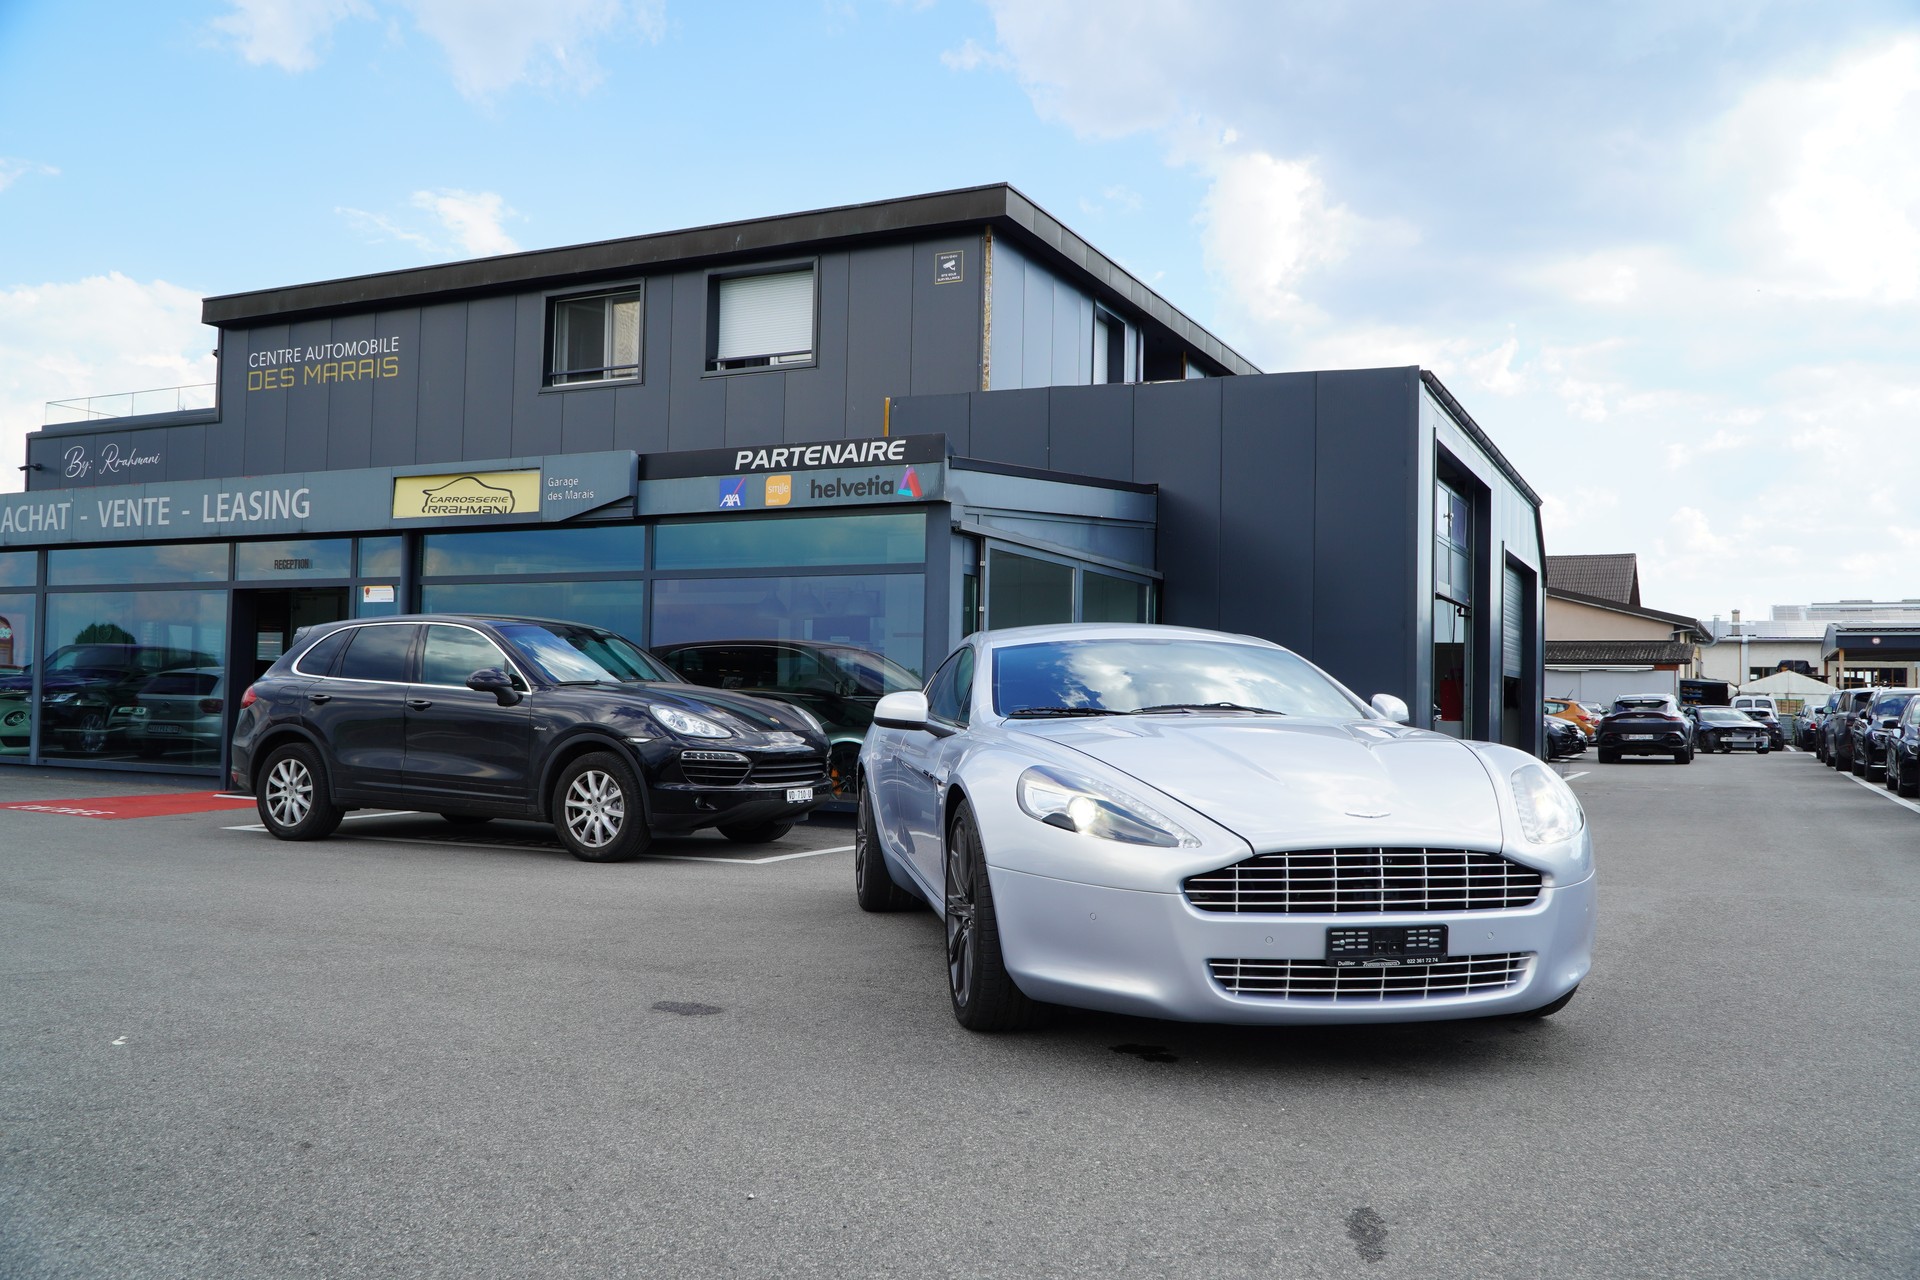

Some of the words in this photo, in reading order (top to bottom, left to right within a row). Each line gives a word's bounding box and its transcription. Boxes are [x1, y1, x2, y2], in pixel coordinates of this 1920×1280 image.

[249, 347, 302, 368] CENTRE
[305, 336, 400, 361] AUTOMOBILE
[248, 367, 295, 391] DES
[304, 356, 399, 386] MARAIS
[64, 445, 93, 478] By:
[99, 443, 160, 475] Rrahmani
[734, 440, 907, 471] PARTENAIRE
[547, 477, 579, 488] Garage
[810, 475, 894, 499] helvetia
[430, 496, 509, 504] CARROSSERIE
[547, 491, 563, 501] des
[565, 490, 594, 500] Marais
[720, 494, 741, 507] AXA
[0, 502, 71, 534] ACHAT
[98, 496, 171, 529] VENTE
[202, 488, 310, 523] LEASING
[274, 558, 310, 570] RECEPTION
